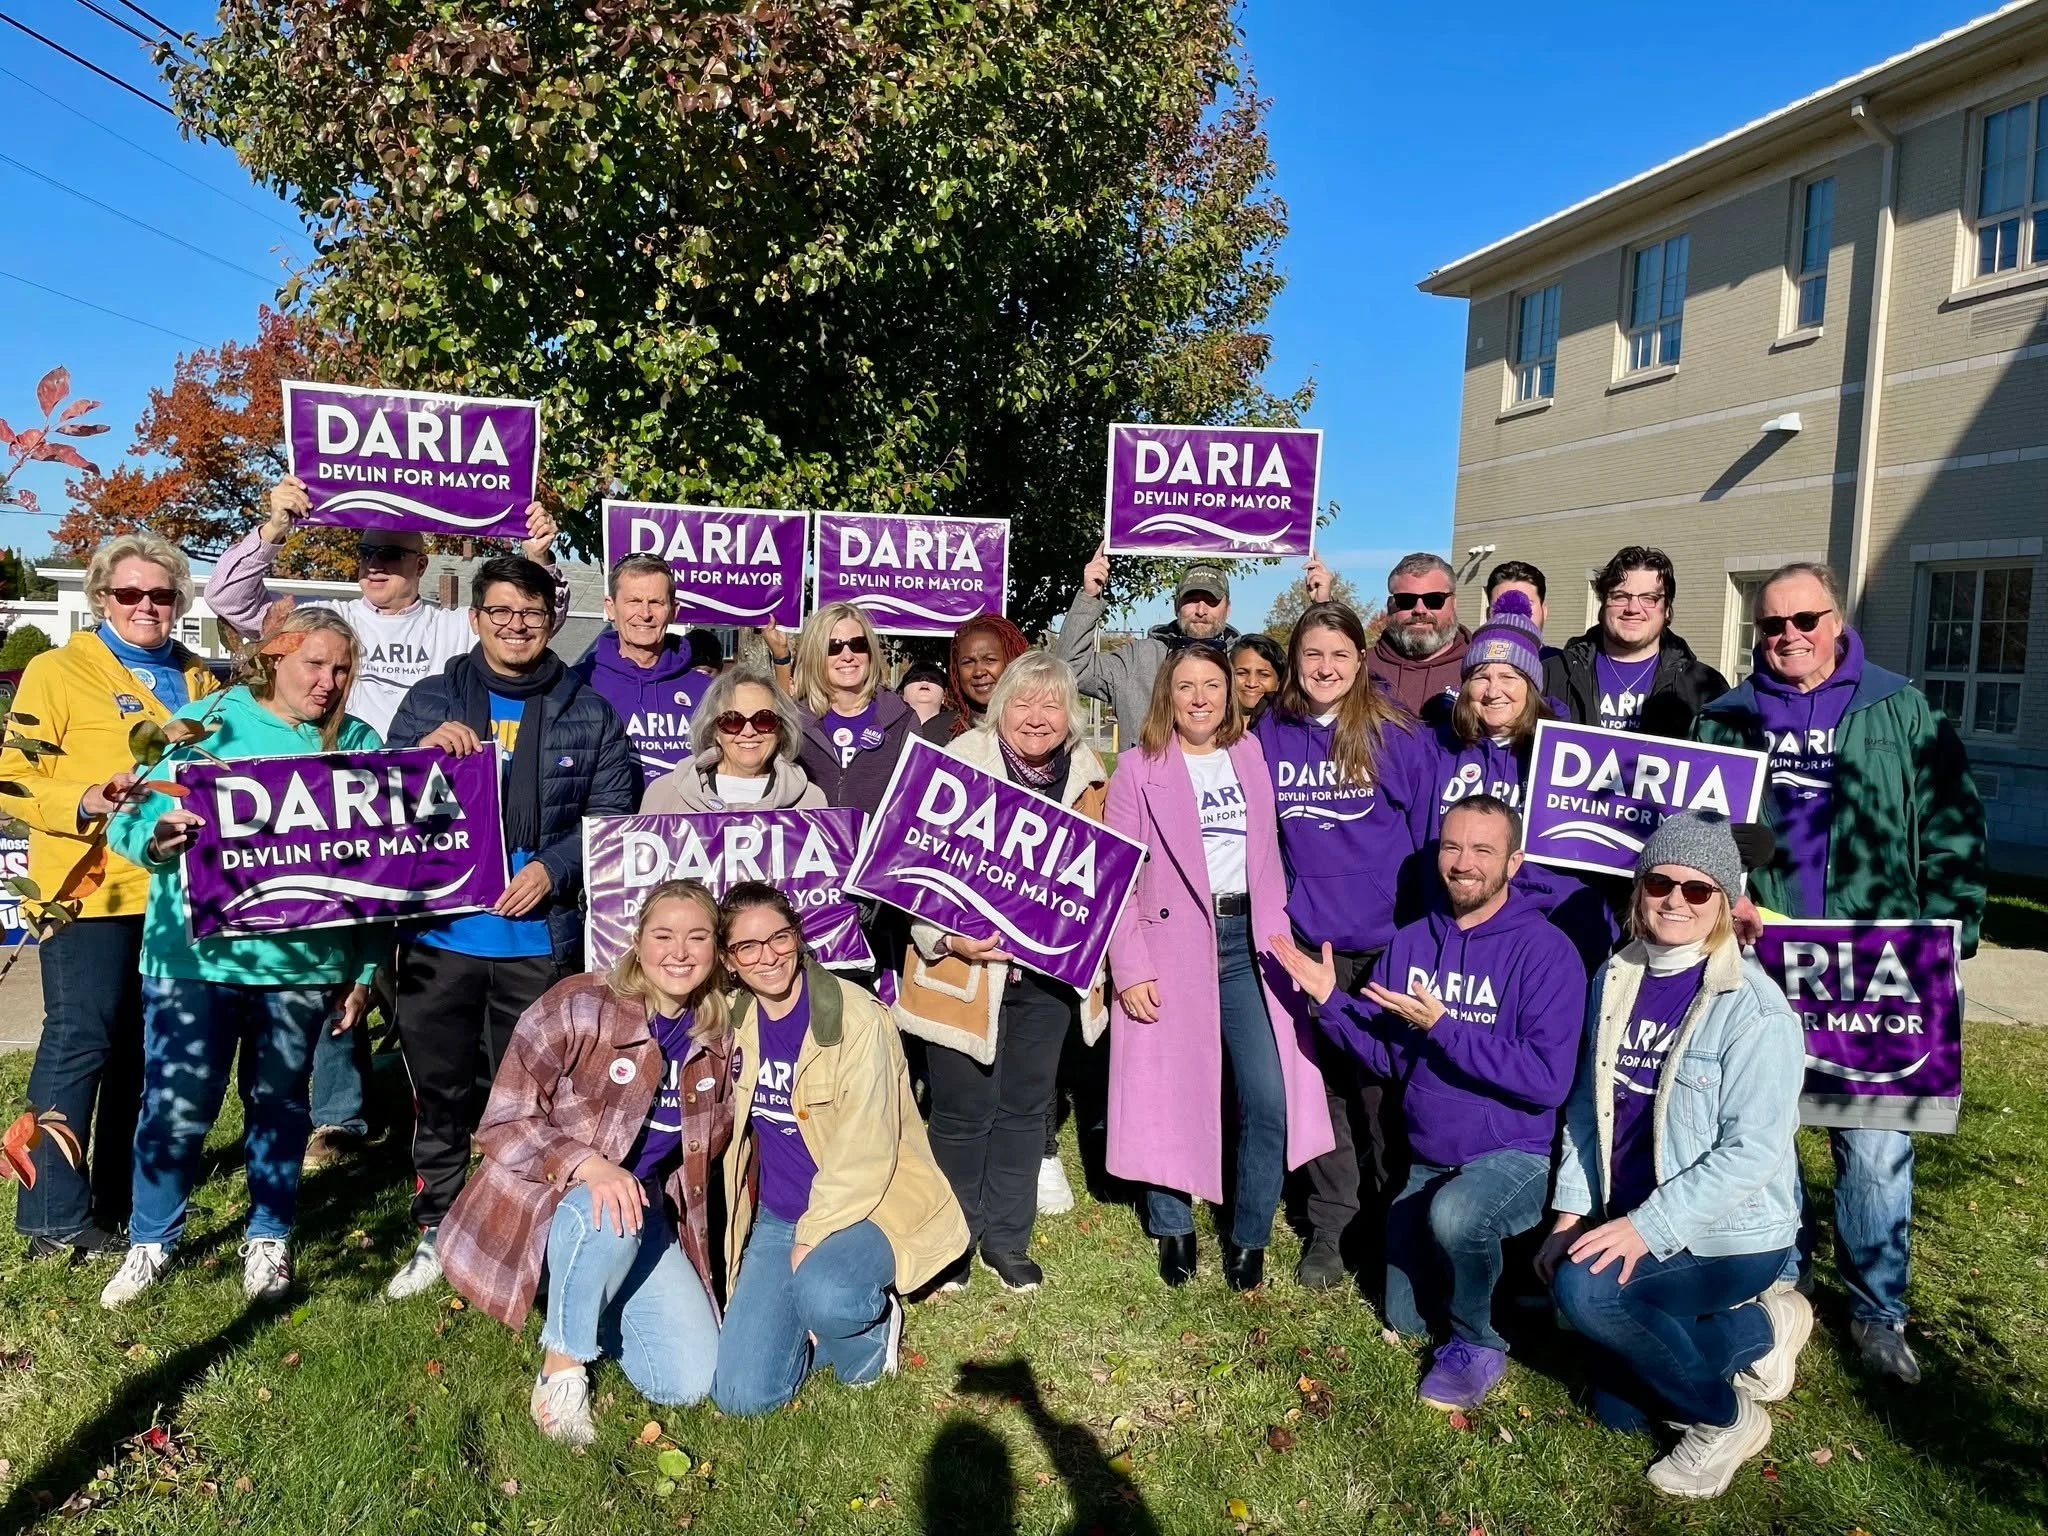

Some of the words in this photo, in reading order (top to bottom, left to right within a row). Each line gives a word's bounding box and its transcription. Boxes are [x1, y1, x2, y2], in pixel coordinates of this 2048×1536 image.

[317, 404, 510, 466] DARIA
[319, 462, 387, 483] DEVLIN
[394, 468, 433, 486] FOR
[439, 472, 511, 490] MAYOR
[1135, 440, 1292, 488] DARIA
[1133, 490, 1189, 506] DEVLIN
[1194, 493, 1226, 508] FOR
[1231, 494, 1292, 510] MAYOR
[630, 518, 782, 566] DARIA
[839, 526, 983, 572] DARIA
[690, 570, 722, 585] FOR
[726, 572, 782, 586] MAYOR
[839, 573, 889, 588] DEVLIN
[894, 576, 924, 590] FOR
[928, 577, 983, 592] MAYOR
[1483, 641, 1511, 660] E
[382, 666, 400, 674] FOR
[1600, 692, 1645, 717] ARI
[626, 712, 691, 737] ARIA
[664, 741, 692, 750] MAYO
[1764, 728, 1835, 755] ARI
[1550, 741, 1731, 816] DARIA
[215, 761, 467, 839] DARIA
[1200, 783, 1247, 811] ARI
[1312, 791, 1332, 801] FOR
[1333, 787, 1375, 800] MAYOR
[1217, 810, 1237, 822] FOR
[1546, 793, 1610, 818] DEVLIN
[1615, 805, 1652, 825] FOR
[915, 767, 1098, 900] DARIA
[222, 843, 312, 870] DEVLIN
[321, 840, 371, 862] FOR
[378, 831, 470, 857] MAYOR
[622, 823, 840, 888] DARIA
[904, 827, 974, 872] DEVLIN
[976, 861, 1017, 892] FOR
[1018, 879, 1091, 925] MAYOR
[784, 887, 842, 909] YOR
[1742, 941, 1921, 1004] RIA
[1827, 1012, 1924, 1035] MAYOR
[758, 1057, 798, 1093] ARI
[769, 1094, 790, 1107] FOR
